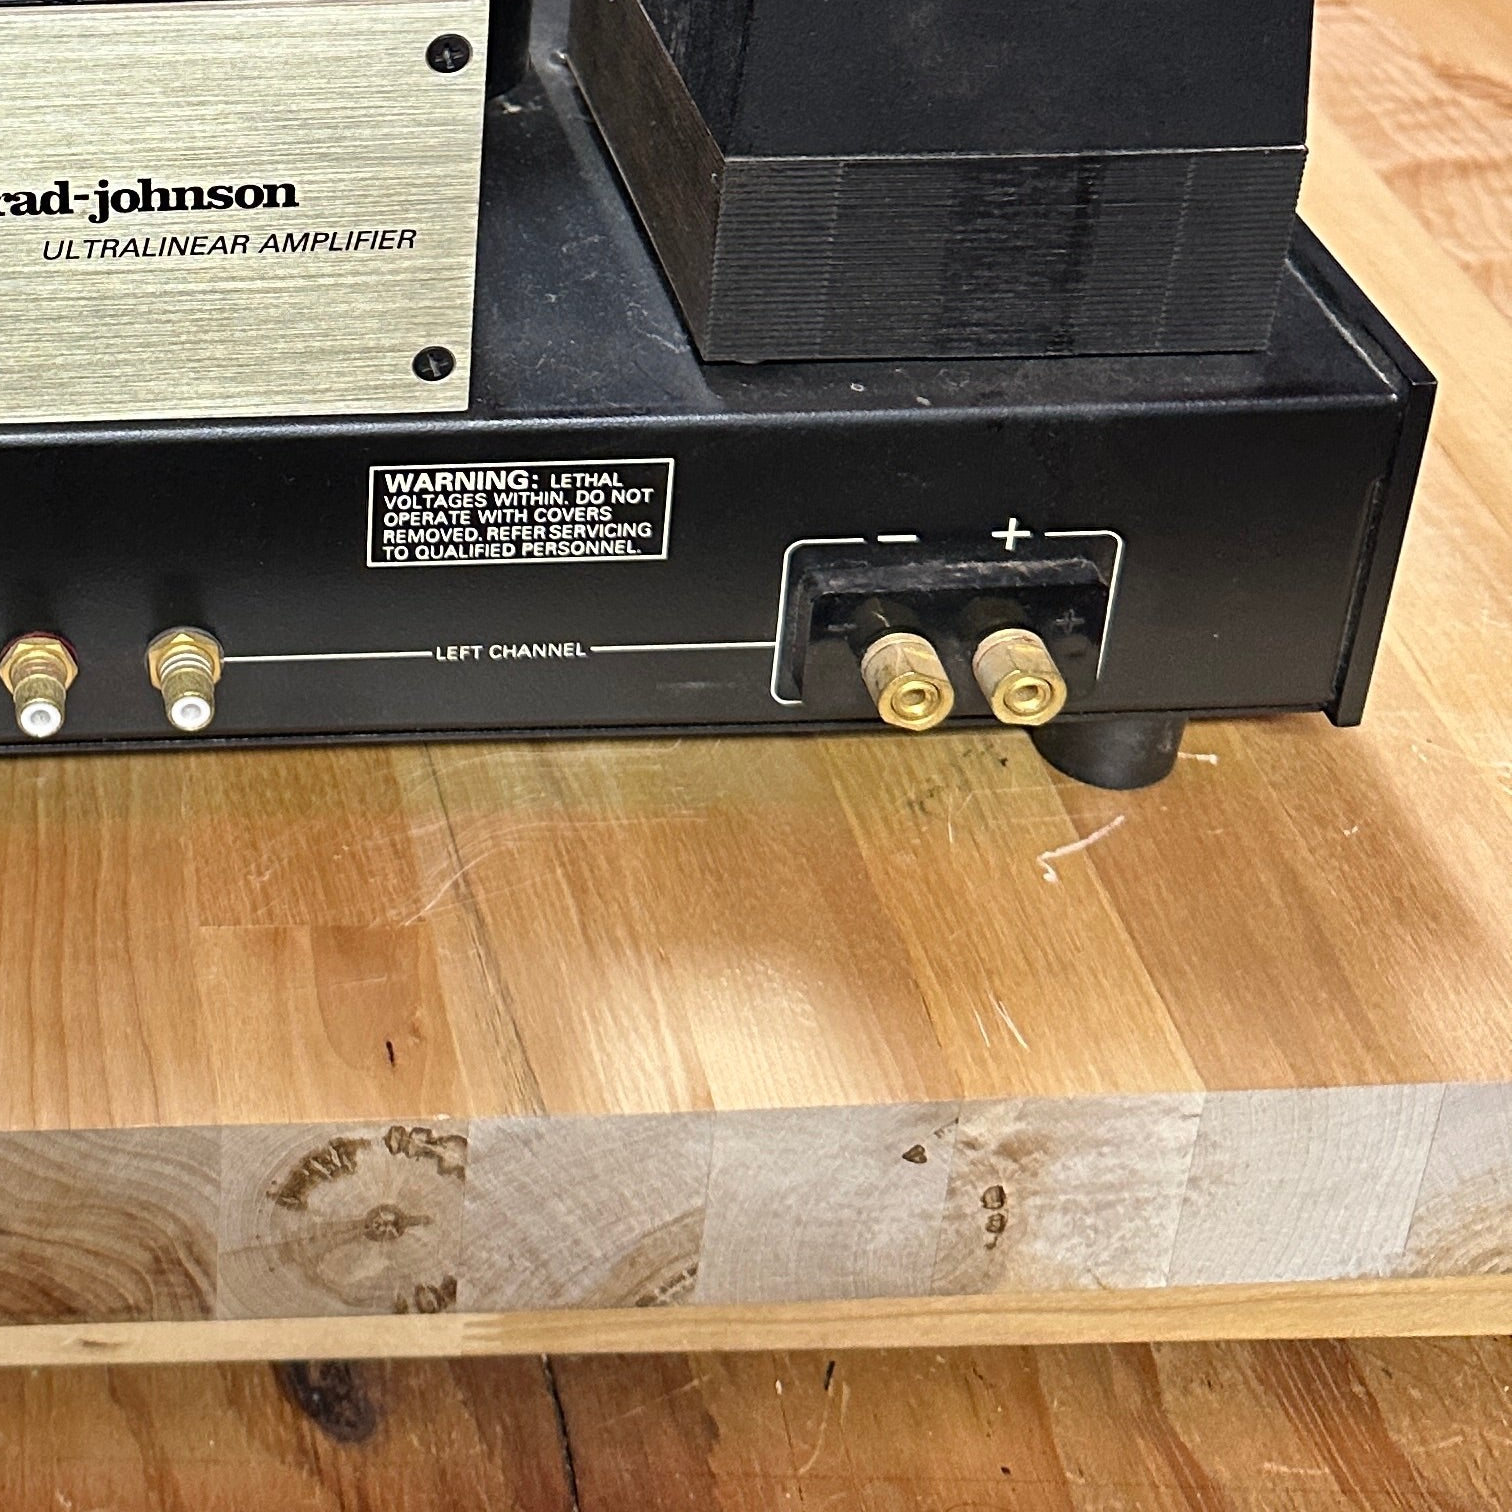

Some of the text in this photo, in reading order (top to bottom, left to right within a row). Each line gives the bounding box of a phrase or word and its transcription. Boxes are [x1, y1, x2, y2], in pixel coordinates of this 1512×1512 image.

[42, 228, 418, 260] ULTRALINEAR AMPLIFIER
[385, 470, 623, 493] WARNING: LETHAL
[384, 488, 655, 510] VOLTAGES WITHIN. DO NOT
[384, 506, 613, 527] OPERATE WITH COVERS
[383, 522, 652, 544] REMOVED. REFER SERVICING
[383, 540, 642, 561] TO QUALIFIED PERSONNEL.
[436, 642, 587, 661] LEFT CHANNEL
